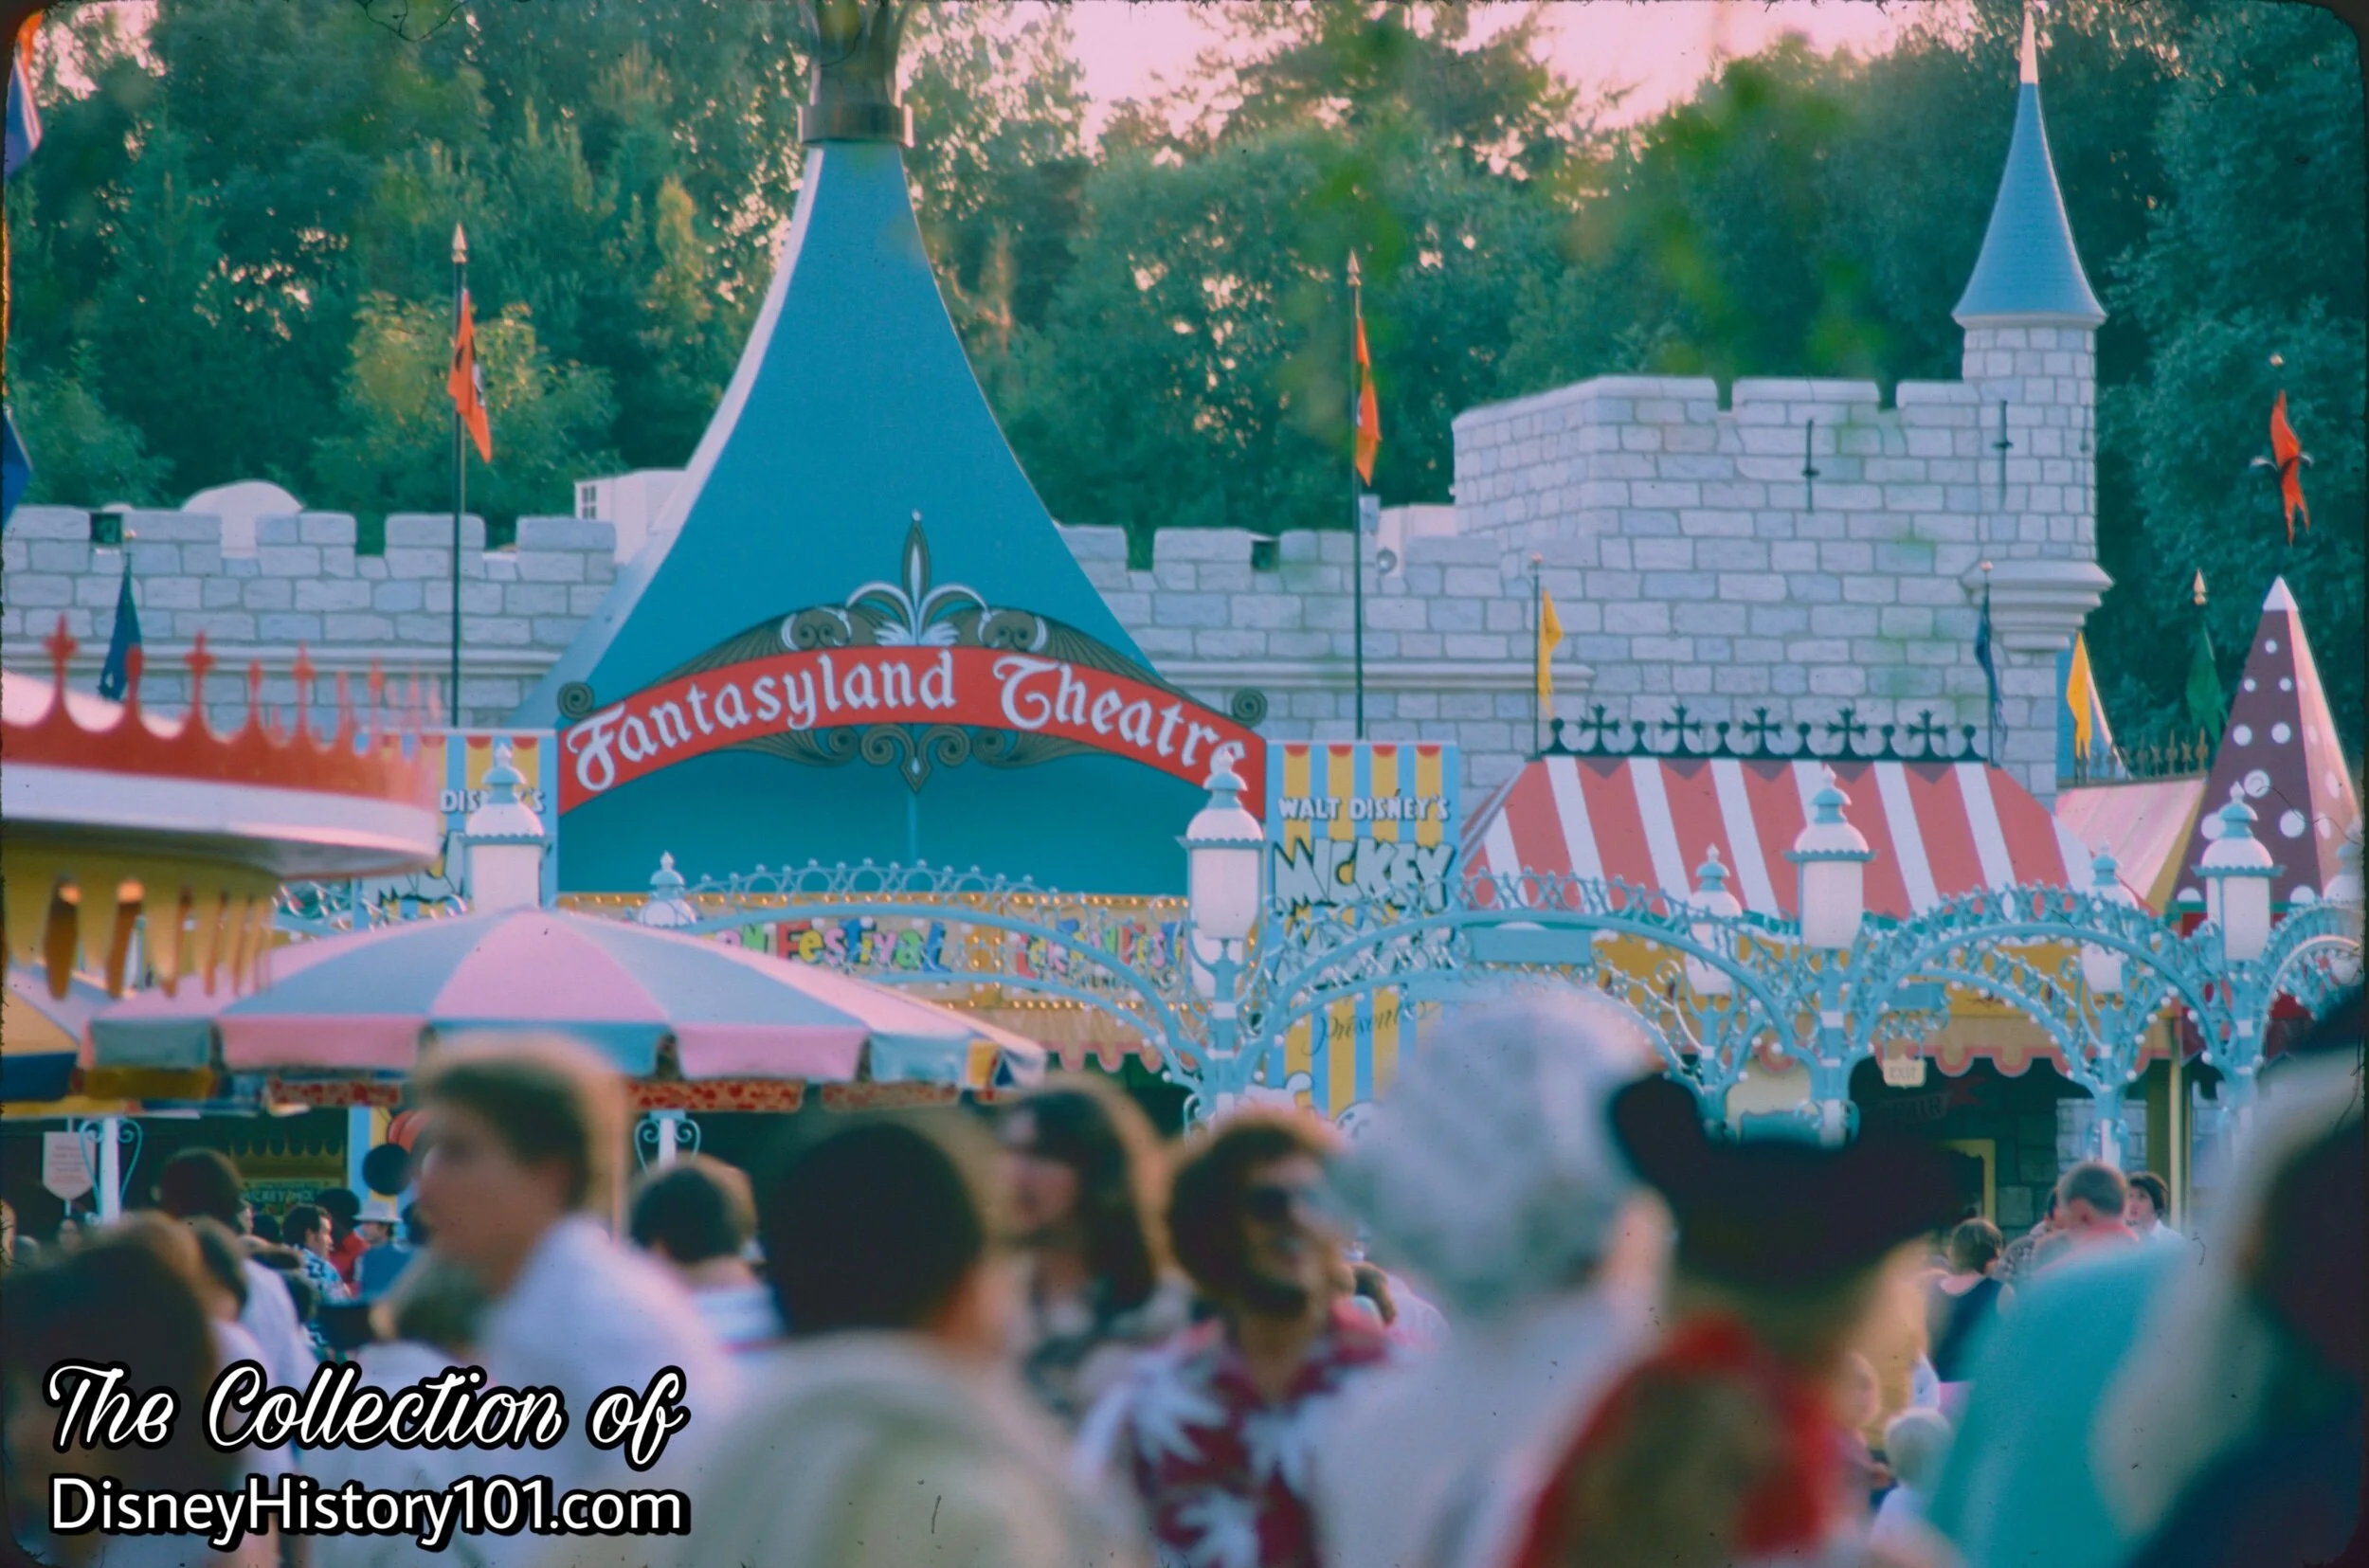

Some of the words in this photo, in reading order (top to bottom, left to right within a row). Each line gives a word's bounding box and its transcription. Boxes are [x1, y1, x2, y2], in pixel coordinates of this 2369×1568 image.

[568, 653, 957, 792] Fantasyland
[1278, 796, 1340, 822] WALT
[1348, 794, 1450, 822] DISNEY'S
[1273, 837, 1456, 917] MICKEY
